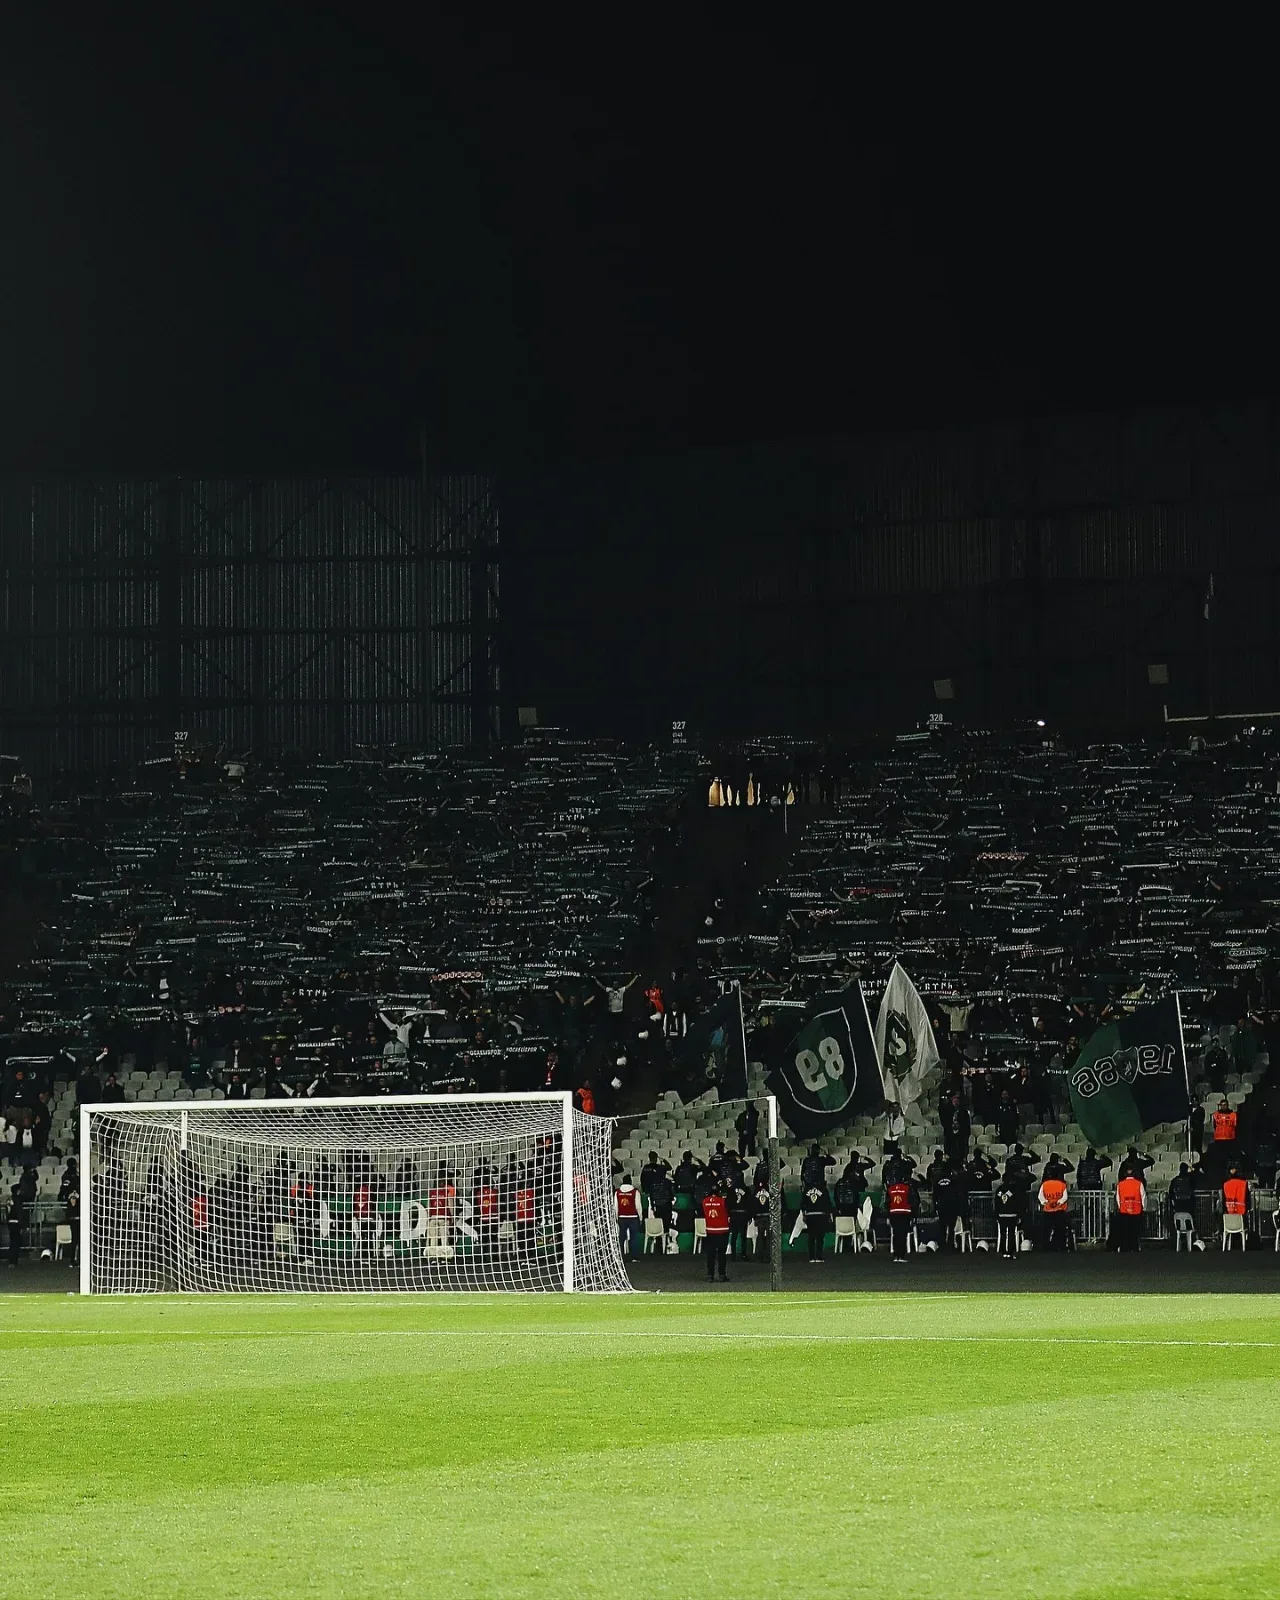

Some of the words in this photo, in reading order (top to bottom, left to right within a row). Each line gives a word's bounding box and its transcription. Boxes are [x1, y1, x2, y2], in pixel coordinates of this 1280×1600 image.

[929, 713, 944, 722] 328
[672, 721, 687, 730] 327
[174, 731, 189, 741] 327
